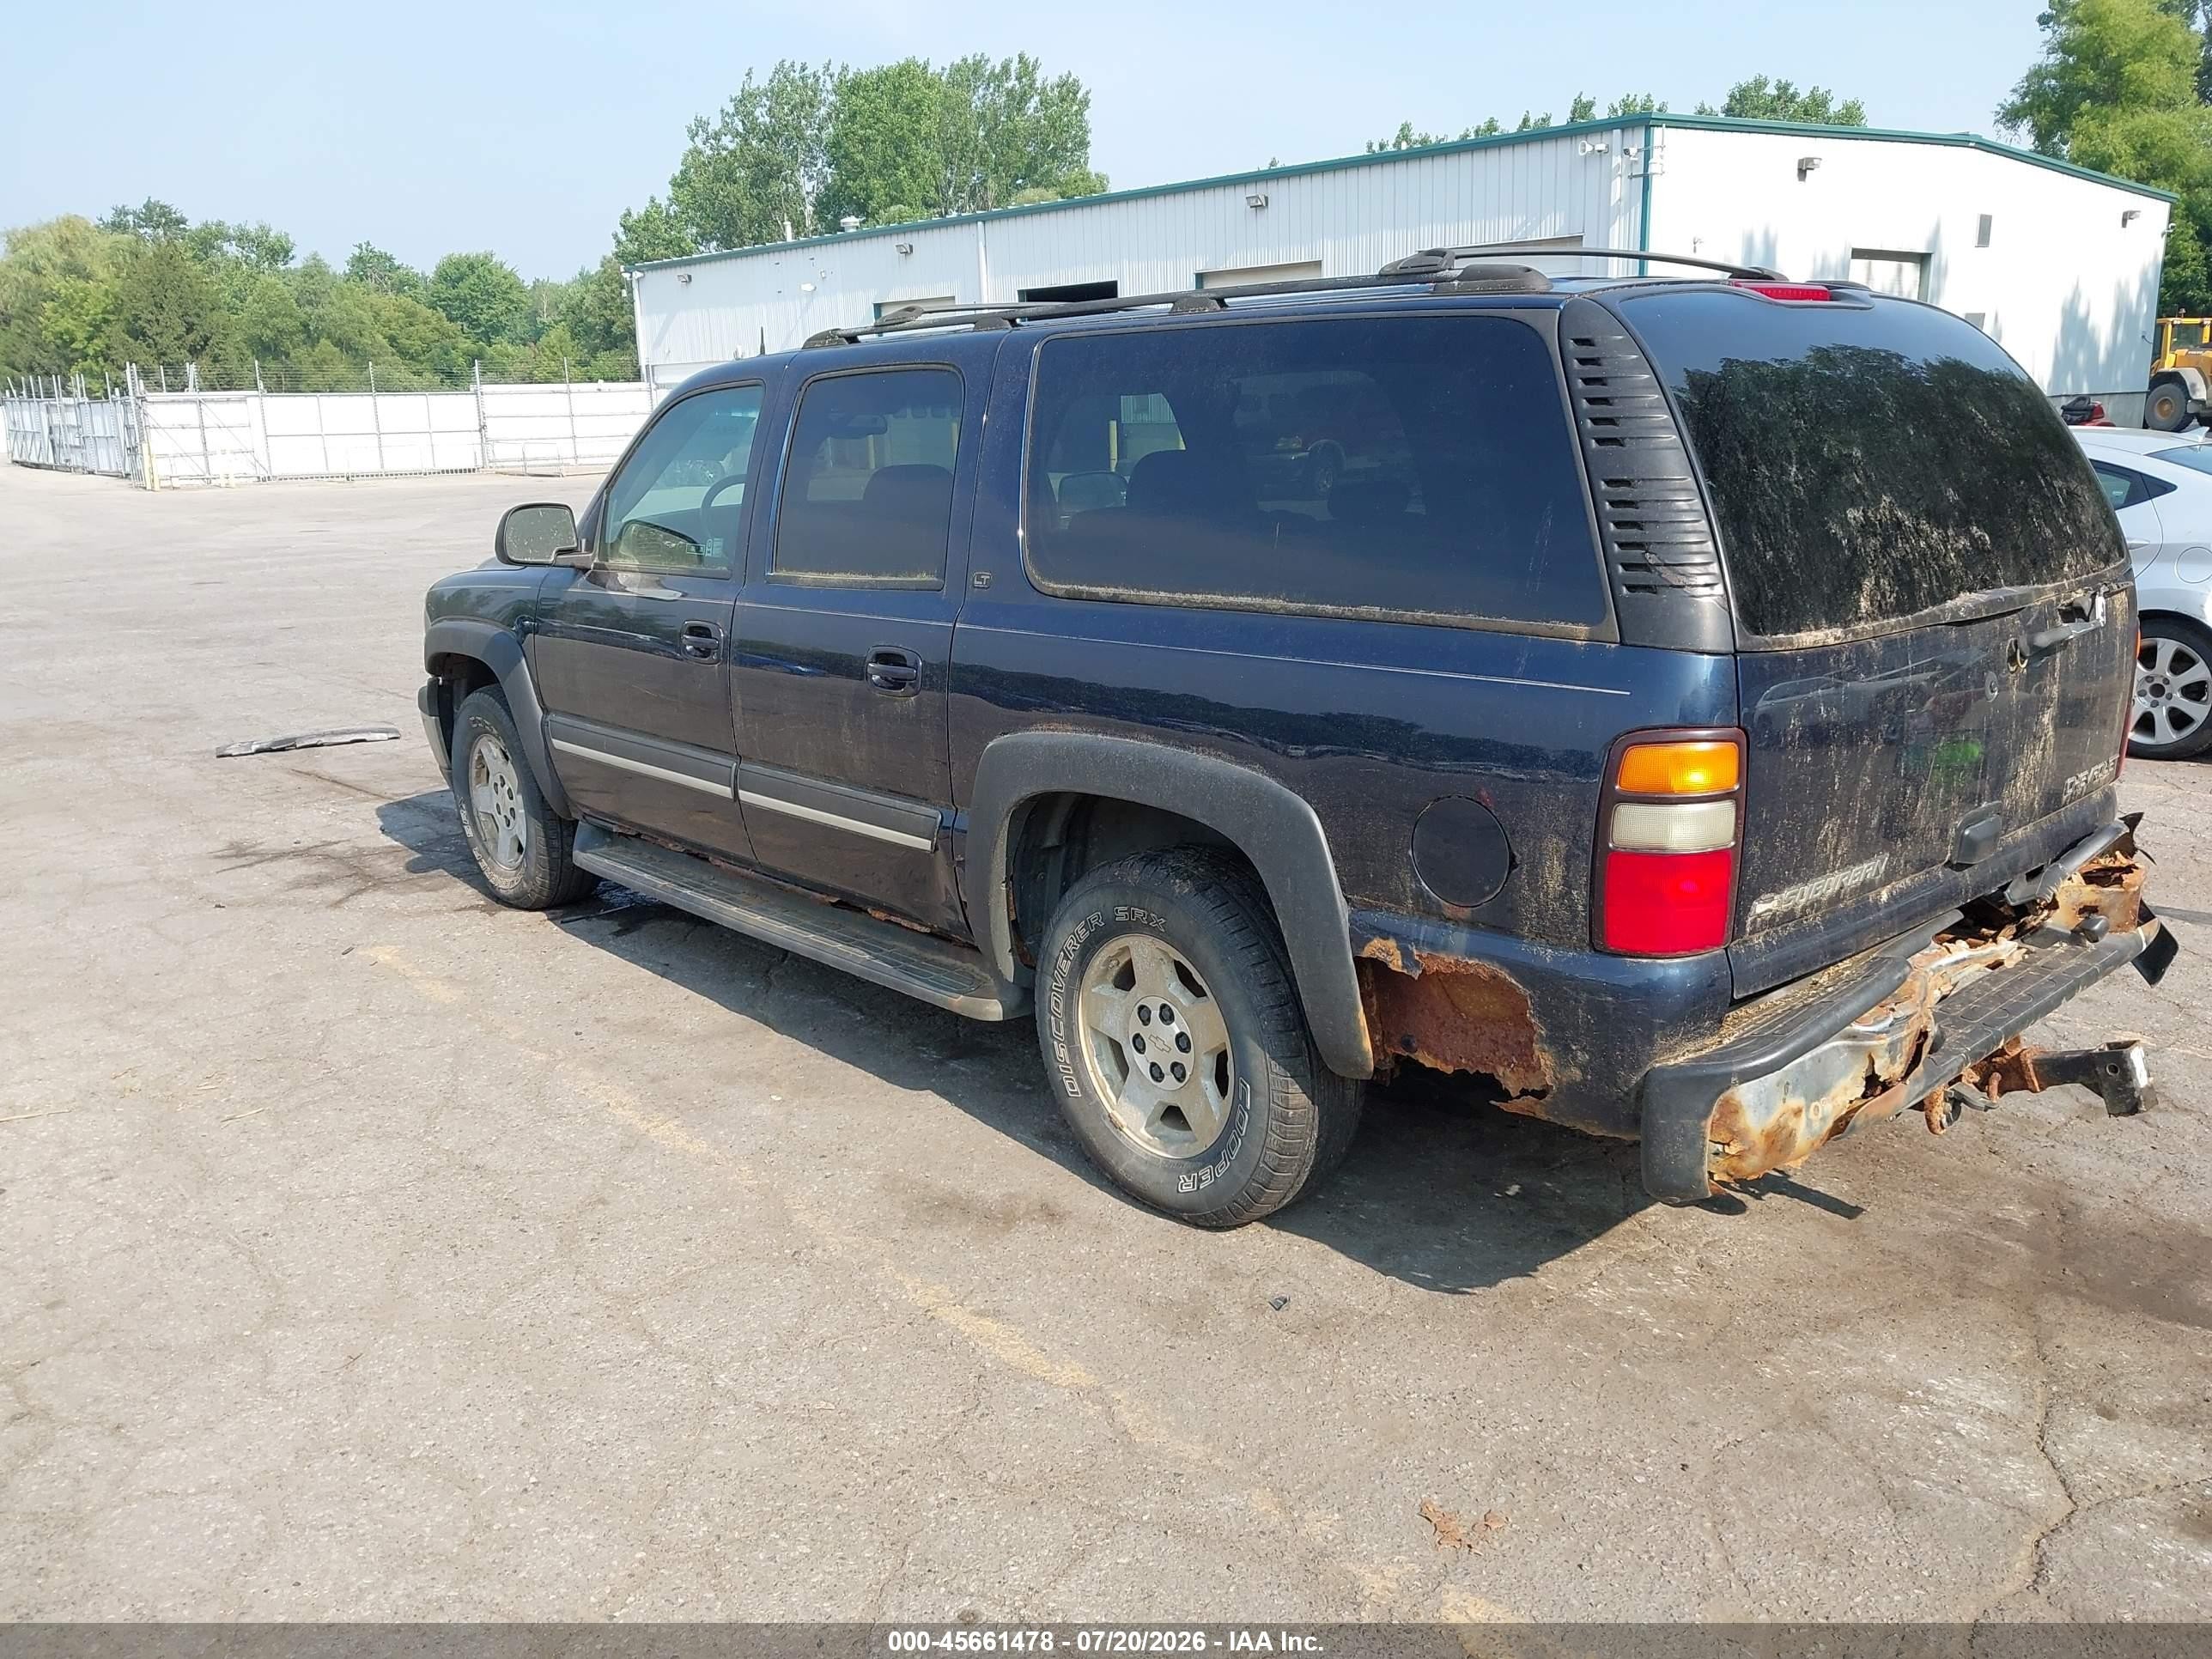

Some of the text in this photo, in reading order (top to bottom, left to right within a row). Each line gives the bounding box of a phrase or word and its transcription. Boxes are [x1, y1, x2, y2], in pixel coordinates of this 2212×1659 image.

[974, 574, 991, 586] LT
[1052, 906, 1168, 1098] DISCOVERER SRX
[1177, 1076, 1251, 1194] COOPER
